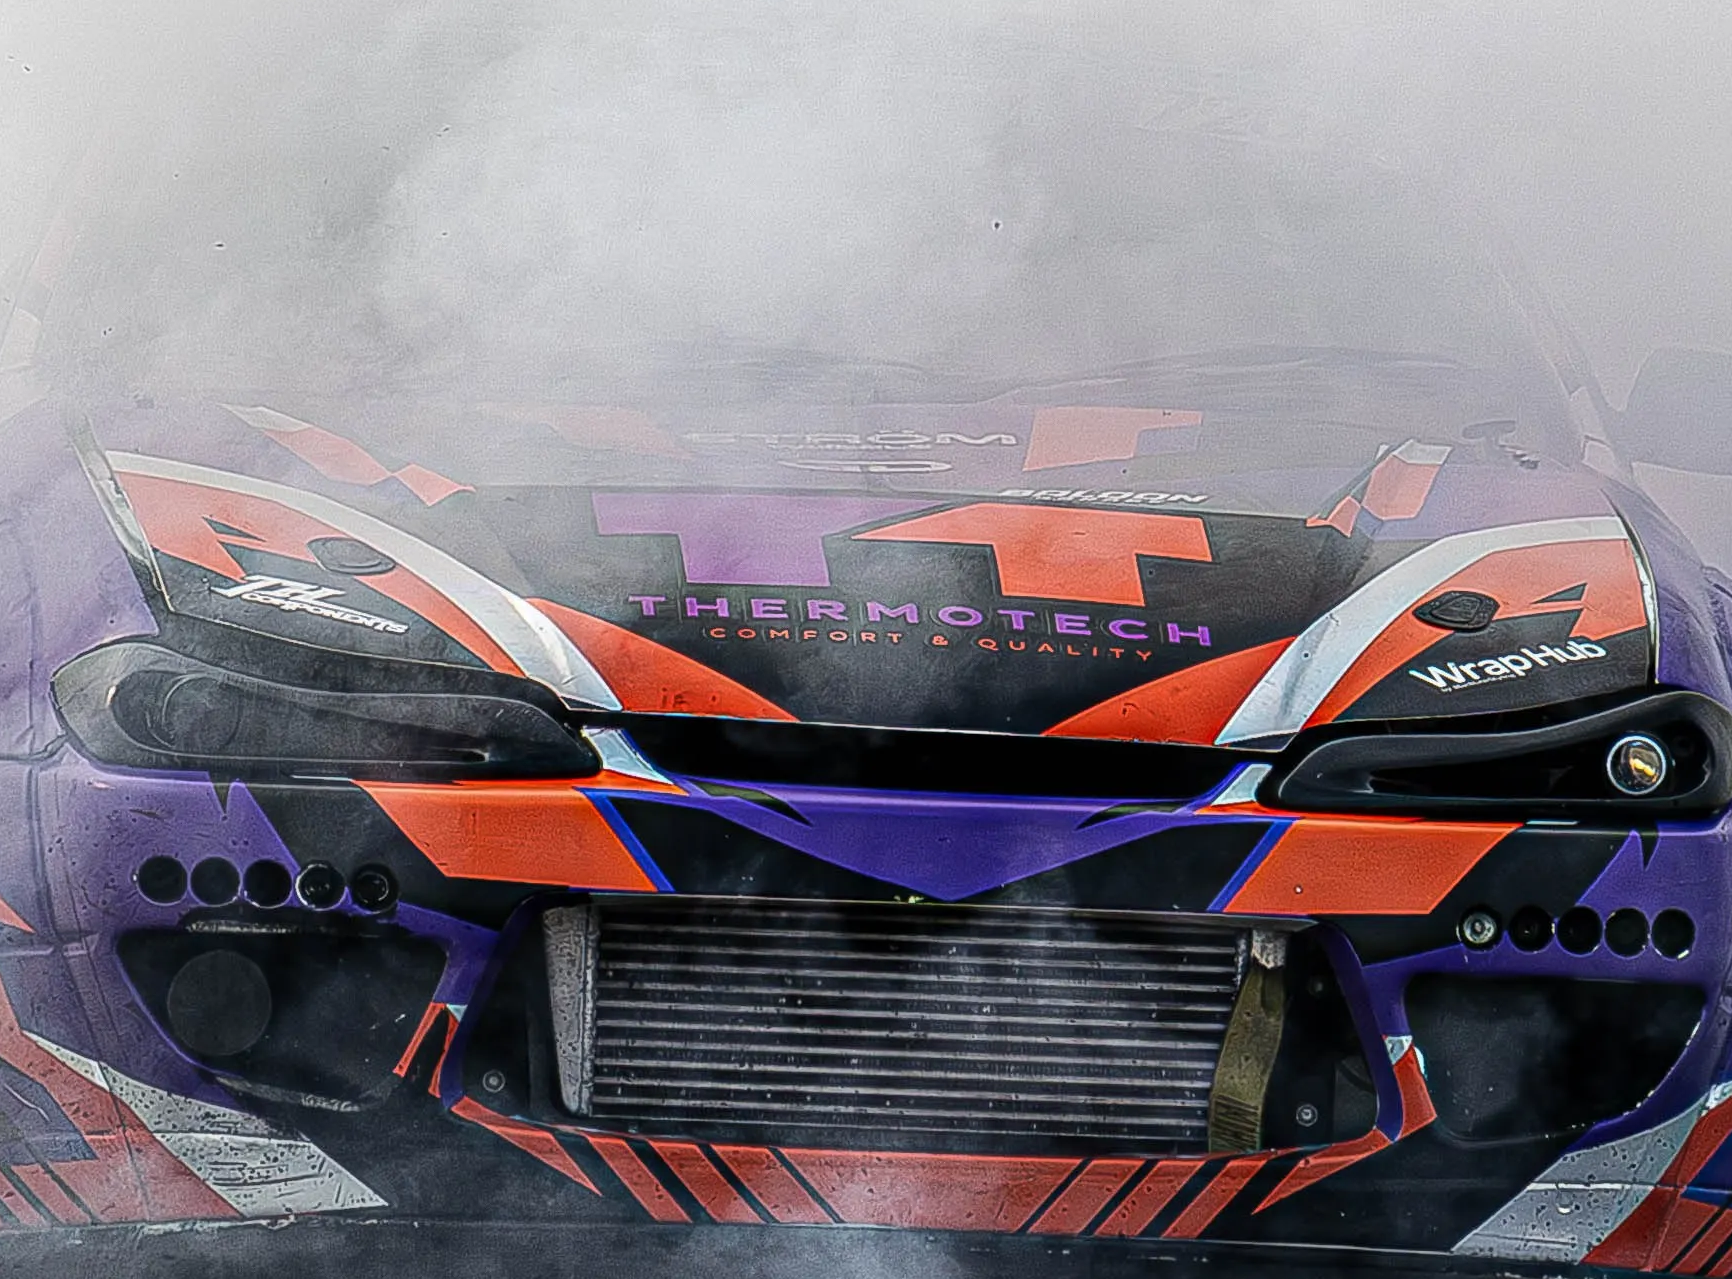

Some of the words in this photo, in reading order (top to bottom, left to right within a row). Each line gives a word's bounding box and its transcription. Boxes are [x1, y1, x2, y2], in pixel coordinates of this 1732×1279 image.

[628, 594, 1213, 648] THERMOTECH
[708, 626, 903, 643] COMFORT
[931, 634, 950, 647] &
[976, 637, 1154, 662] QUALITY
